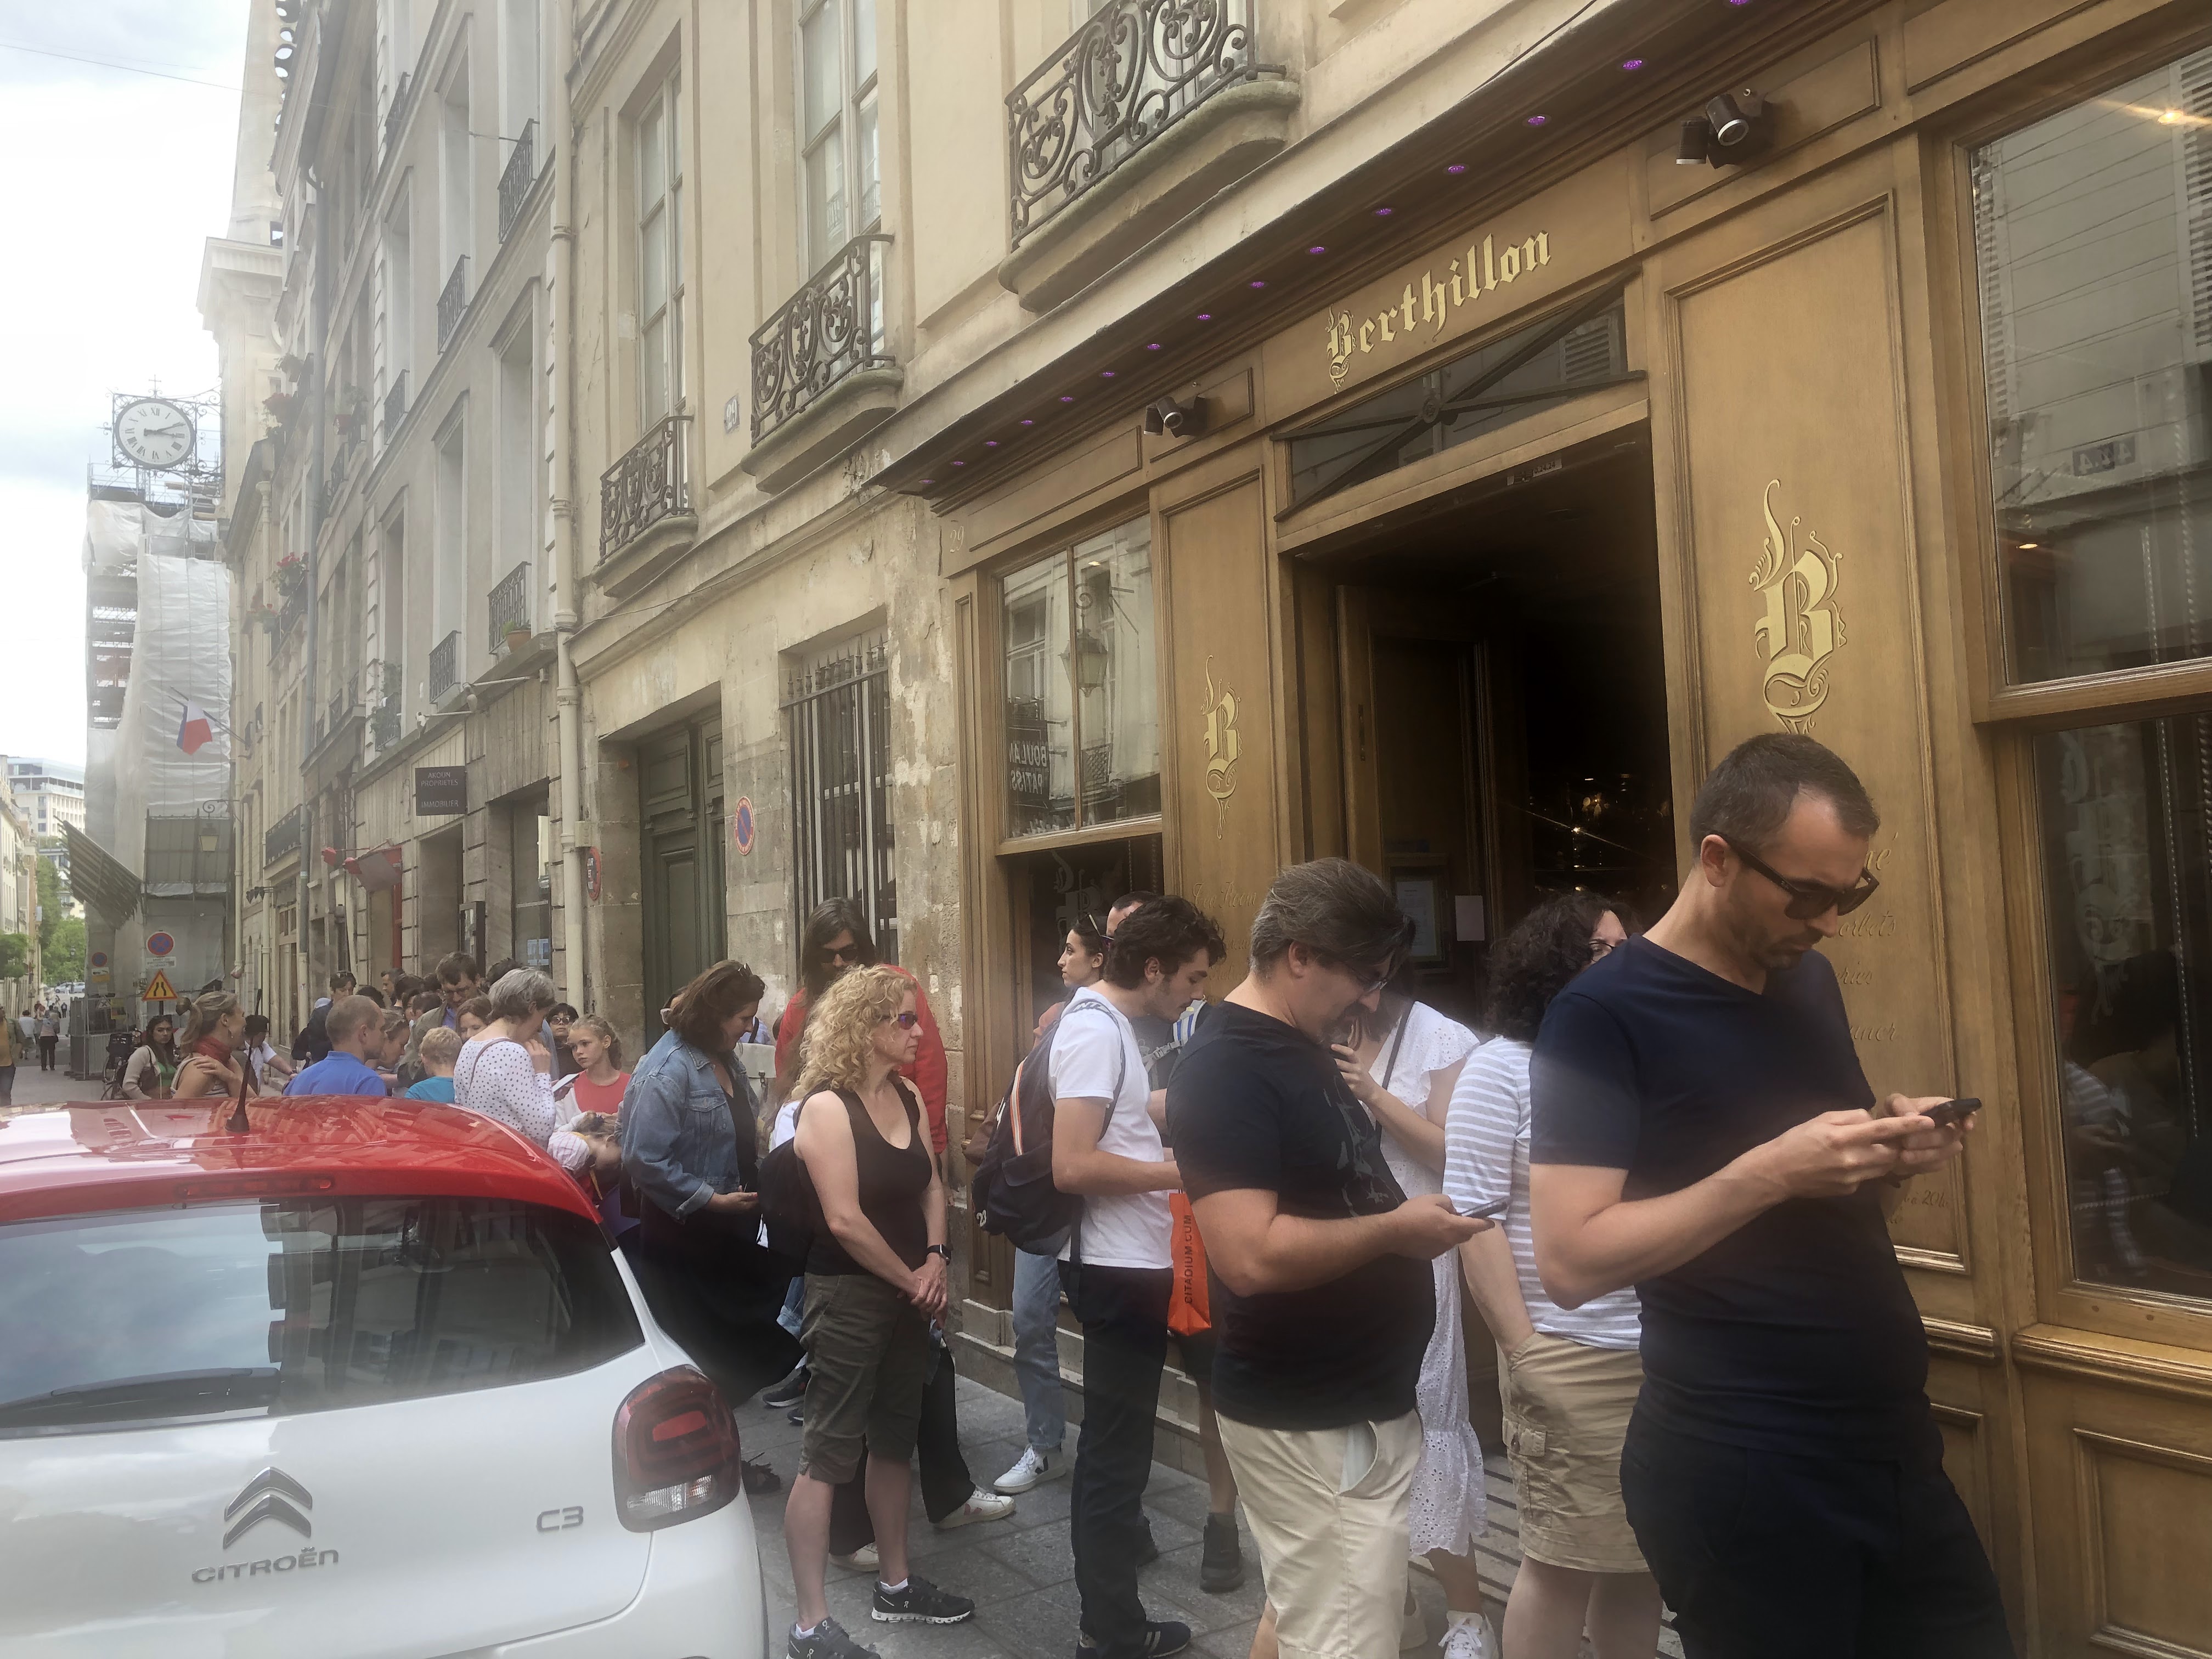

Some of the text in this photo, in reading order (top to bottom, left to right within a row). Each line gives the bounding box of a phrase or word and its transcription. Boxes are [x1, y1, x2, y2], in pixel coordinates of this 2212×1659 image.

[1325, 230, 1551, 394] Berthillon
[726, 399, 737, 430] 29
[950, 526, 964, 552] 29
[1200, 655, 1243, 840] B
[421, 800, 459, 808] IMMOBILIER
[1839, 912, 1896, 937] orbets
[537, 1505, 584, 1532] C3
